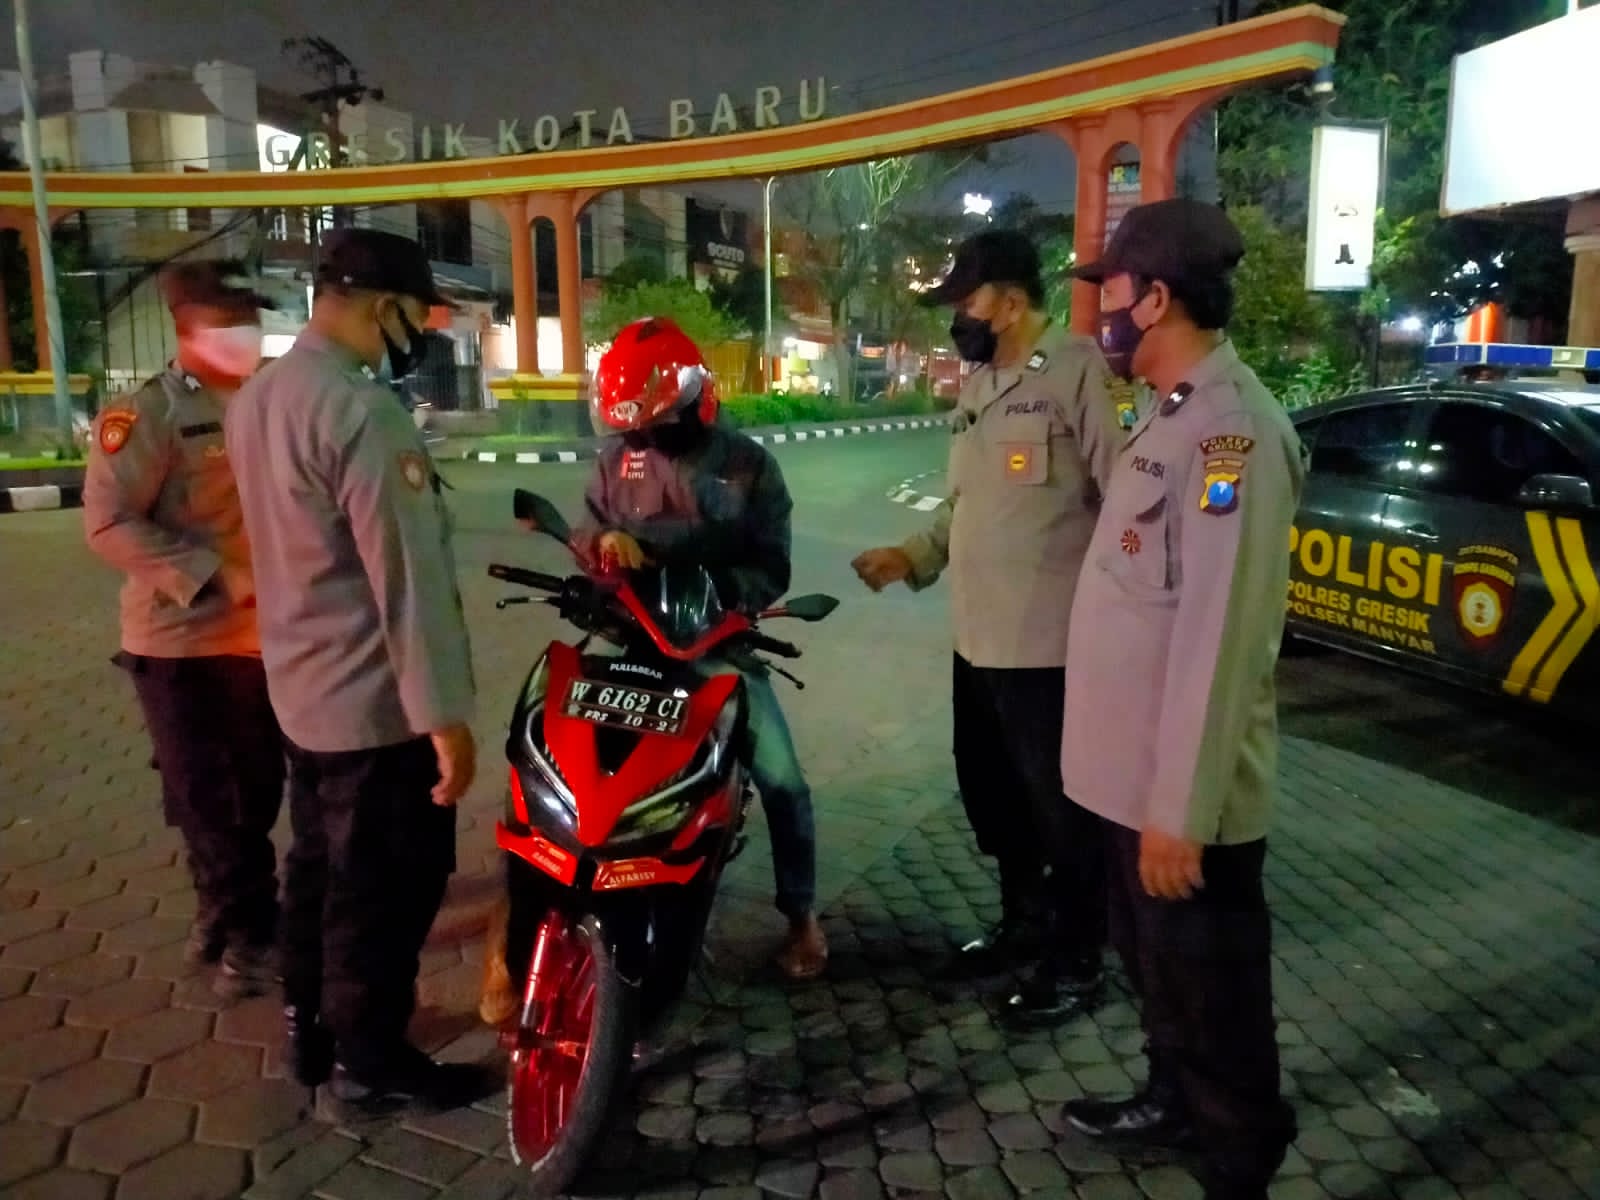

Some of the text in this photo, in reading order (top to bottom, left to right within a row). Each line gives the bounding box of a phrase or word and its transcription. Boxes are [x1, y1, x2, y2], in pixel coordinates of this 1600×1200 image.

[265, 77, 826, 169] GRESIK KOTA BARU
[1005, 401, 1048, 416] POLRI
[1286, 600, 1437, 654] POLSEK MANYAR
[1287, 579, 1430, 633] POLRES GRESIK
[610, 663, 663, 679] PULL&BEAR
[571, 681, 684, 719] W 6162 CI
